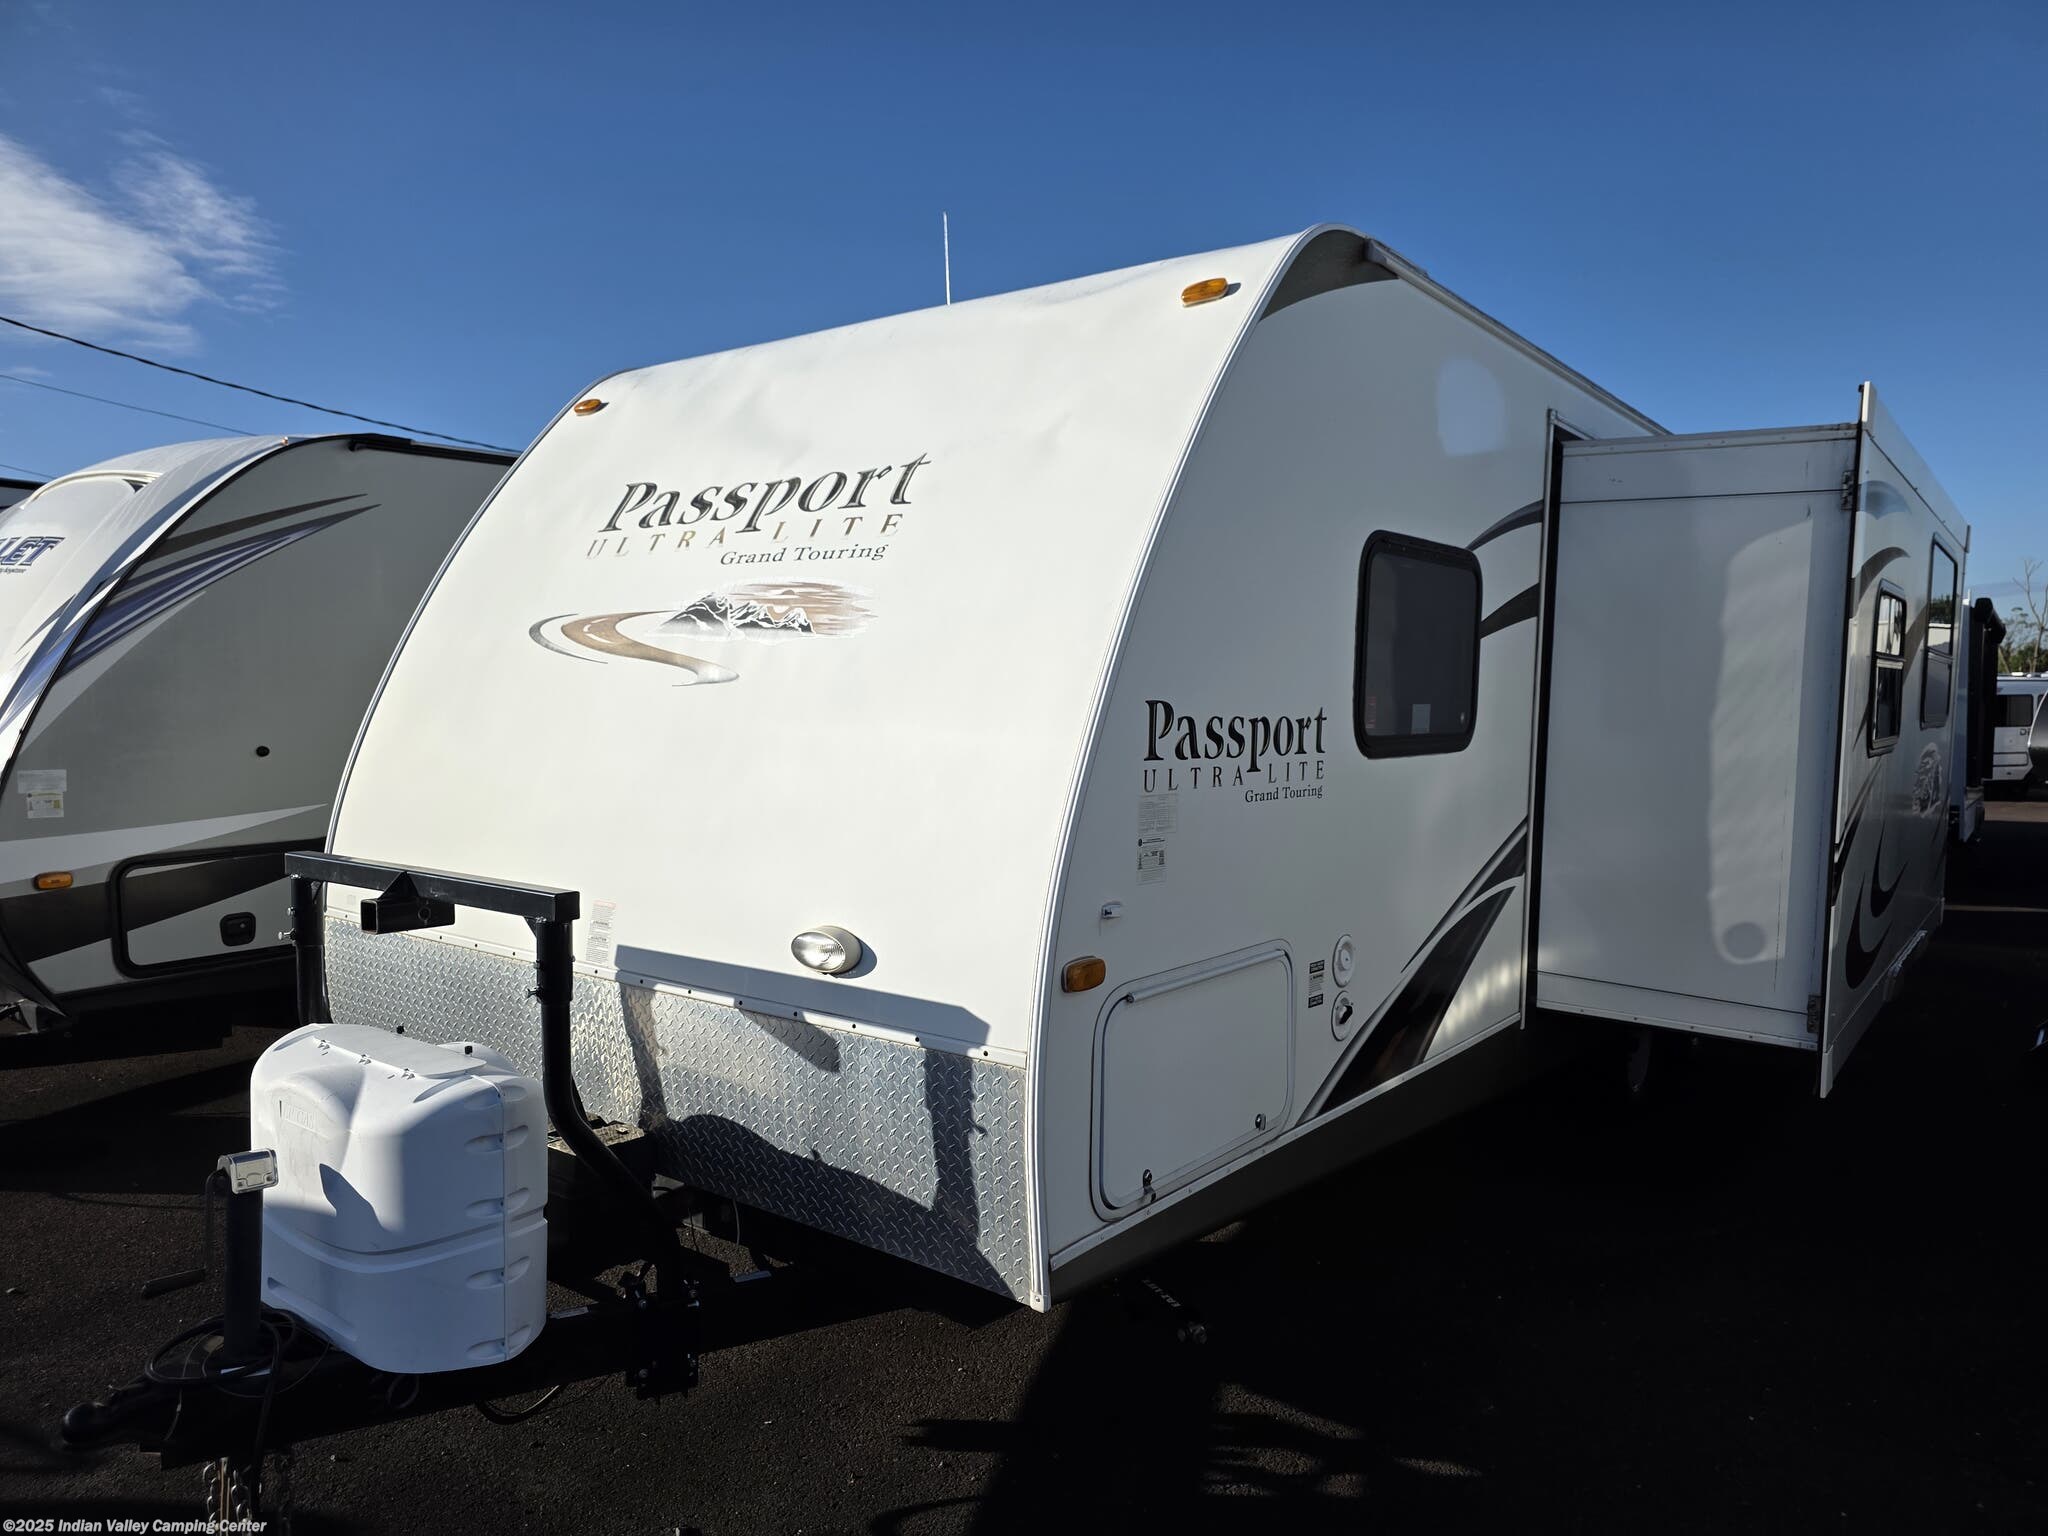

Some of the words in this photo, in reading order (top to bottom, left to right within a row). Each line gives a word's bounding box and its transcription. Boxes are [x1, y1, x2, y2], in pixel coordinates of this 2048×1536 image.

[598, 453, 932, 534] Passport
[586, 527, 726, 560] ULTRA
[771, 513, 904, 544] LITE
[720, 547, 788, 566] Grand
[793, 543, 889, 561] Touring
[1143, 699, 1328, 773] Passport
[1143, 765, 1244, 793] ULTRA
[1267, 760, 1324, 784] LITE
[1244, 786, 1279, 803] Grand
[1282, 783, 1323, 799] Touring
